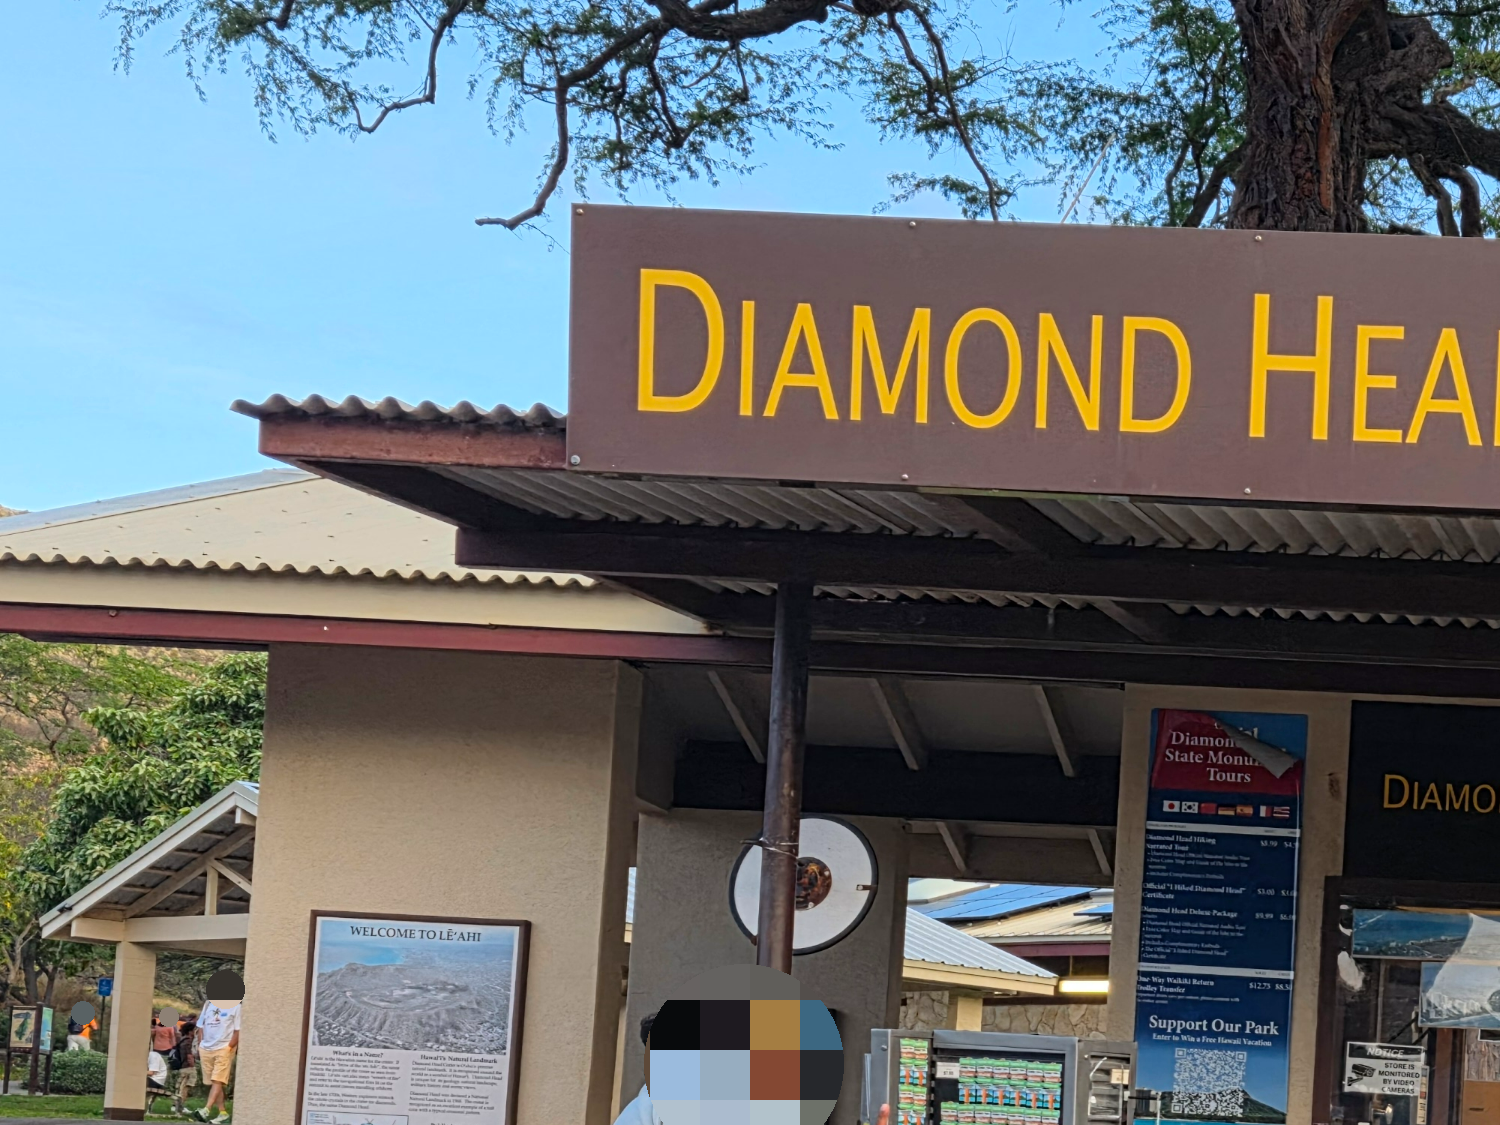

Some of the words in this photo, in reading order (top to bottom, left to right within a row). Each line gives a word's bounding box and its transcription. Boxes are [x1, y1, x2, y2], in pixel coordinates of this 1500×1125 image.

[637, 268, 1192, 433] DIAMOND
[1171, 731, 1236, 748] Diamon
[1165, 748, 1204, 763] State
[1207, 751, 1261, 766] Monu
[1207, 767, 1251, 783] Tours
[350, 926, 416, 939] WELCOME
[418, 929, 437, 940] TO
[1149, 1014, 1208, 1034] Support
[1211, 1018, 1242, 1033] Our
[1245, 1020, 1280, 1035] Park
[1180, 1034, 1196, 1042] Win
[1202, 1036, 1217, 1044] Free
[1218, 1036, 1242, 1045] Hawaii
[1242, 1038, 1272, 1046] Vacation
[1366, 1048, 1405, 1058] NOTICE
[1384, 1062, 1408, 1070] STORE
[1378, 1070, 1420, 1078] MONITORED
[1382, 1086, 1414, 1094] CAMERAS
